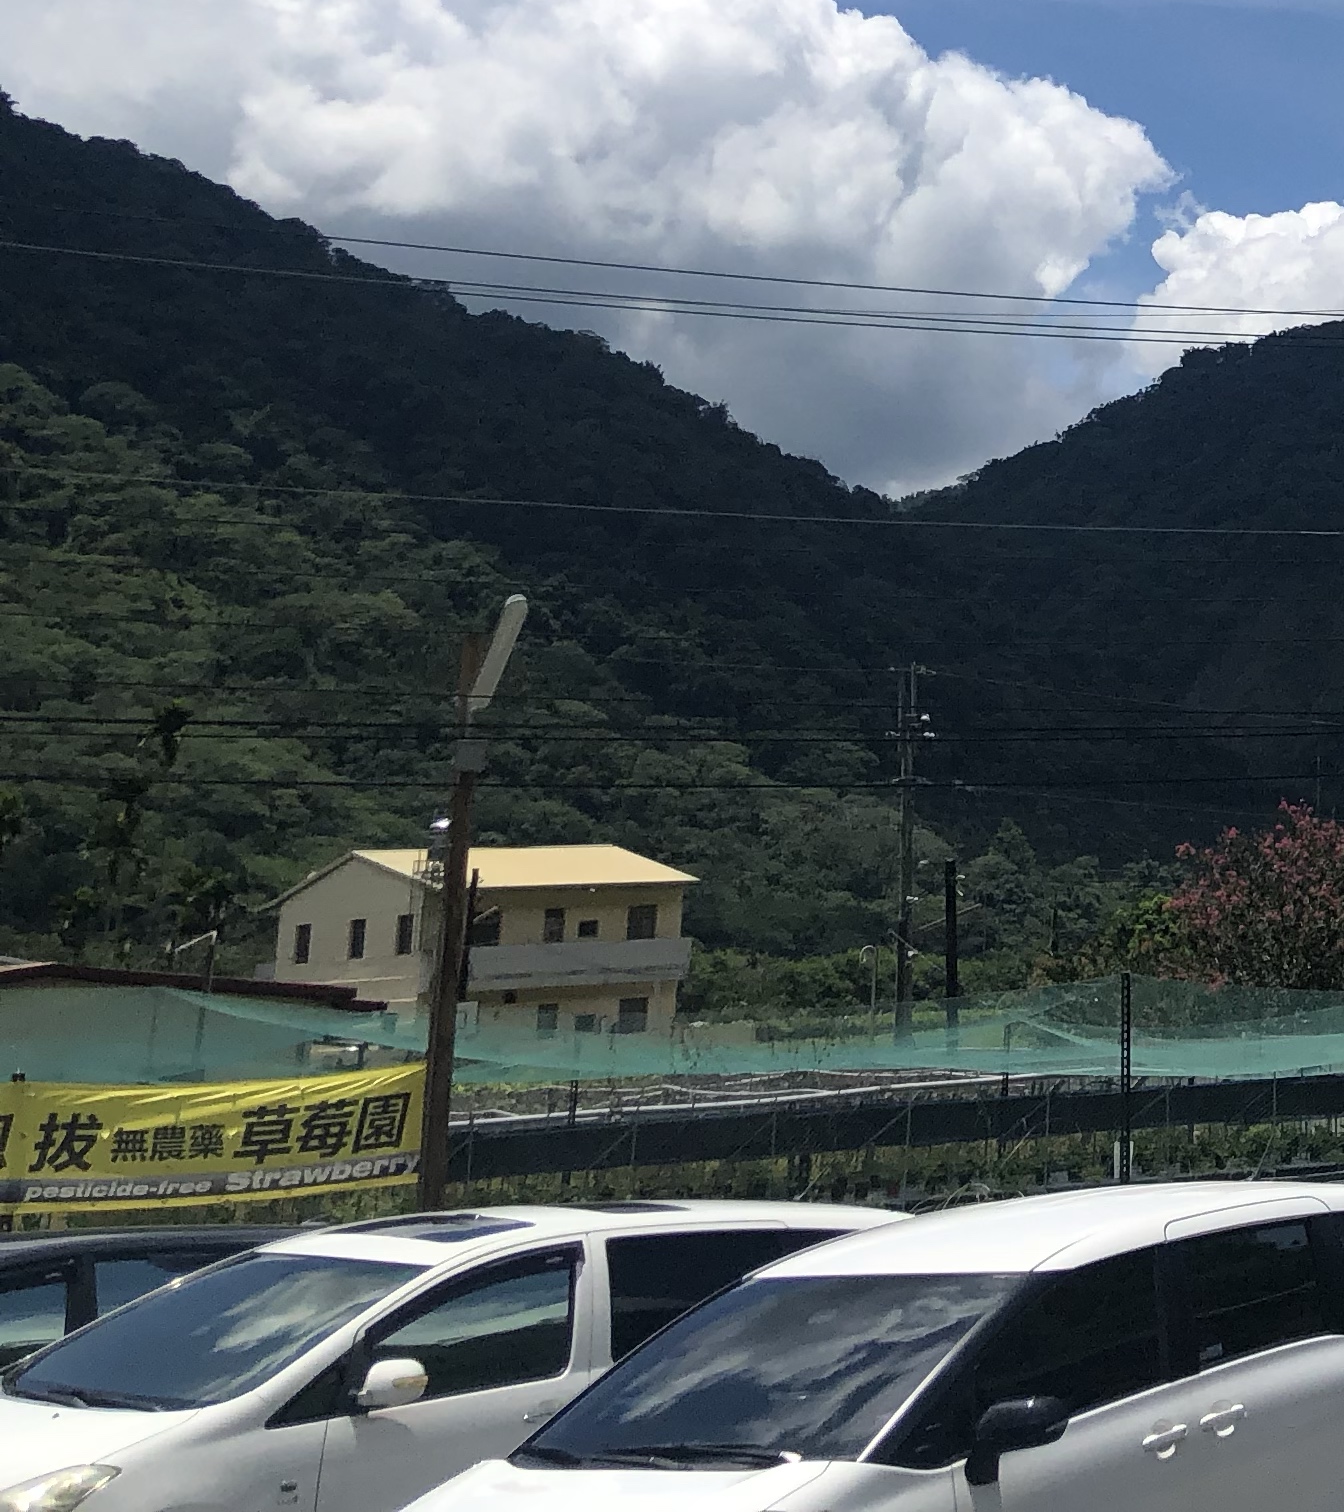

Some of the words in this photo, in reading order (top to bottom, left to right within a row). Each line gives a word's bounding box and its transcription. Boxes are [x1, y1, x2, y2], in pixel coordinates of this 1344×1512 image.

[110, 1123, 226, 1164] 無農藥
[232, 1092, 412, 1166] 草莓園
[23, 1178, 212, 1203] pesticide-free
[225, 1154, 420, 1192] Strawberry
